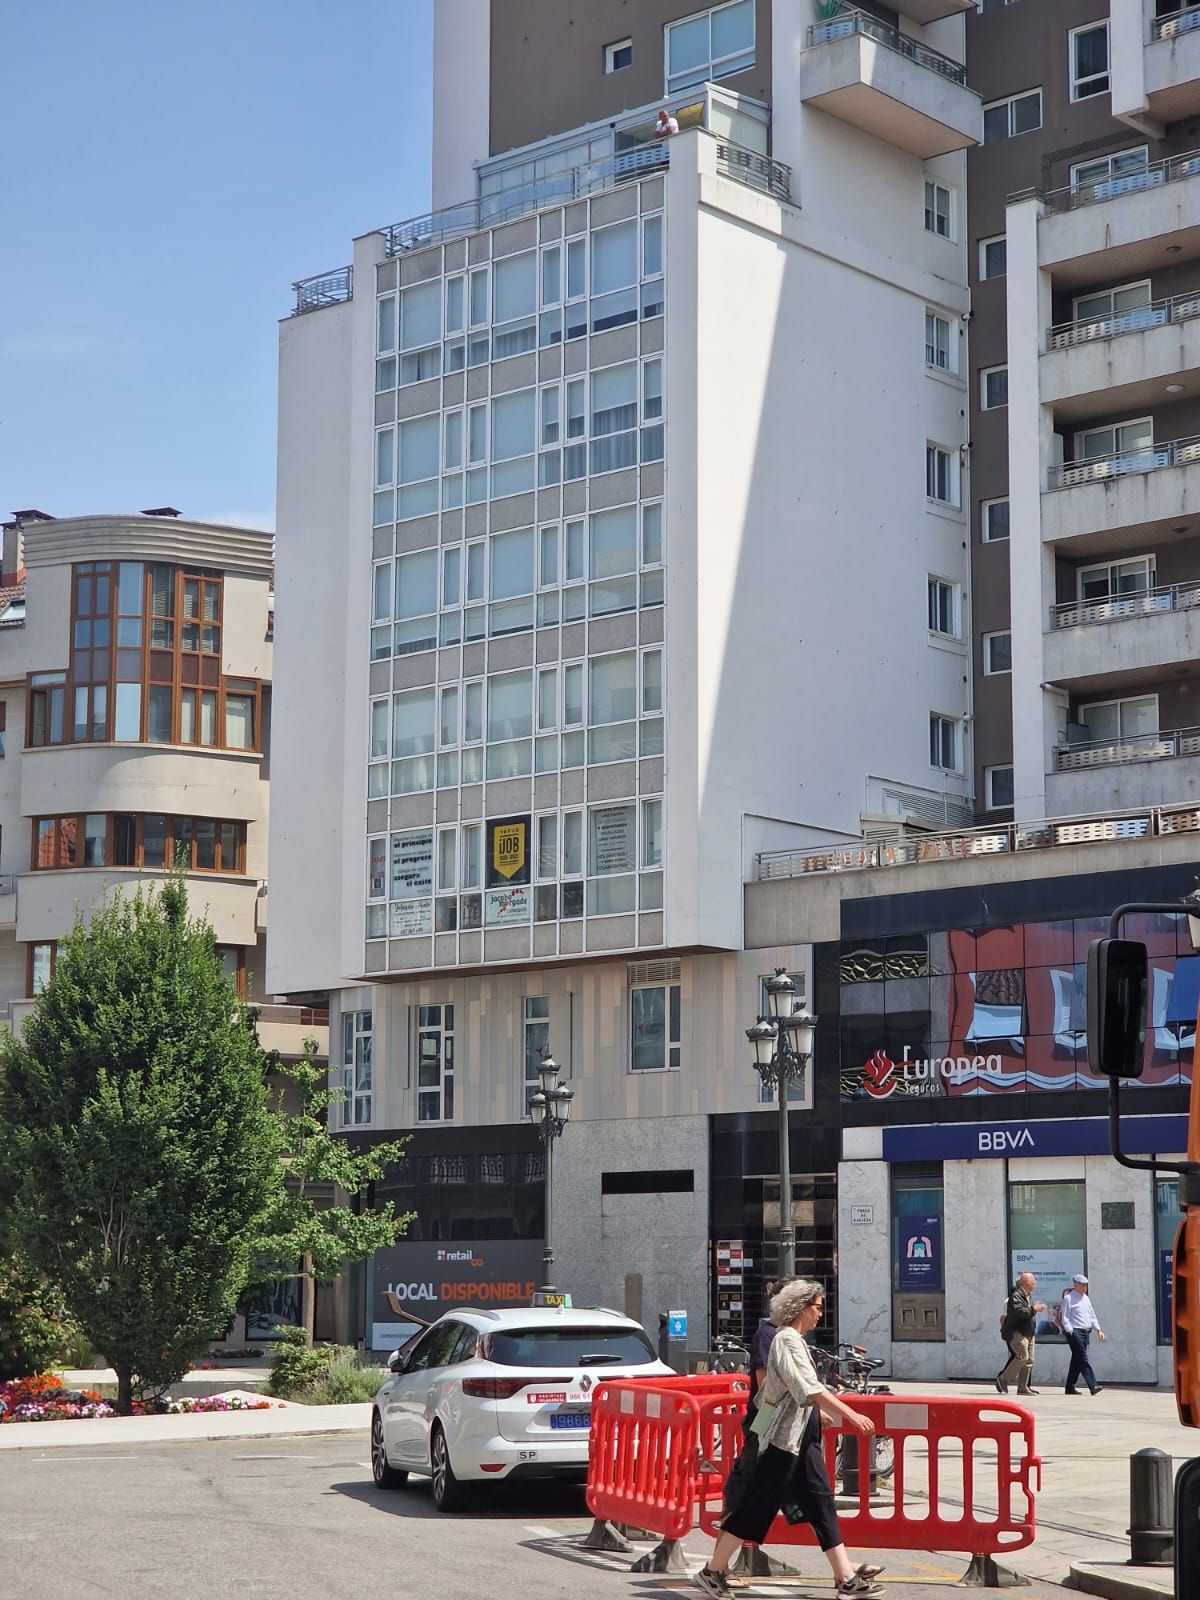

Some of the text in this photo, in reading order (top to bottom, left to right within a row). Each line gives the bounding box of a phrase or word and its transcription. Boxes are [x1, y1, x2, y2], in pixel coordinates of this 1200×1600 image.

[903, 1045, 1002, 1085] Europea
[904, 1081, 940, 1096] Seguros
[978, 1128, 1035, 1151] BBVA
[446, 1250, 473, 1260] retail
[1016, 1254, 1035, 1262] BBVA
[388, 1282, 535, 1301] LOCAL DISPONIBLE
[545, 1295, 564, 1305] TAXI
[519, 1451, 536, 1460] SP
